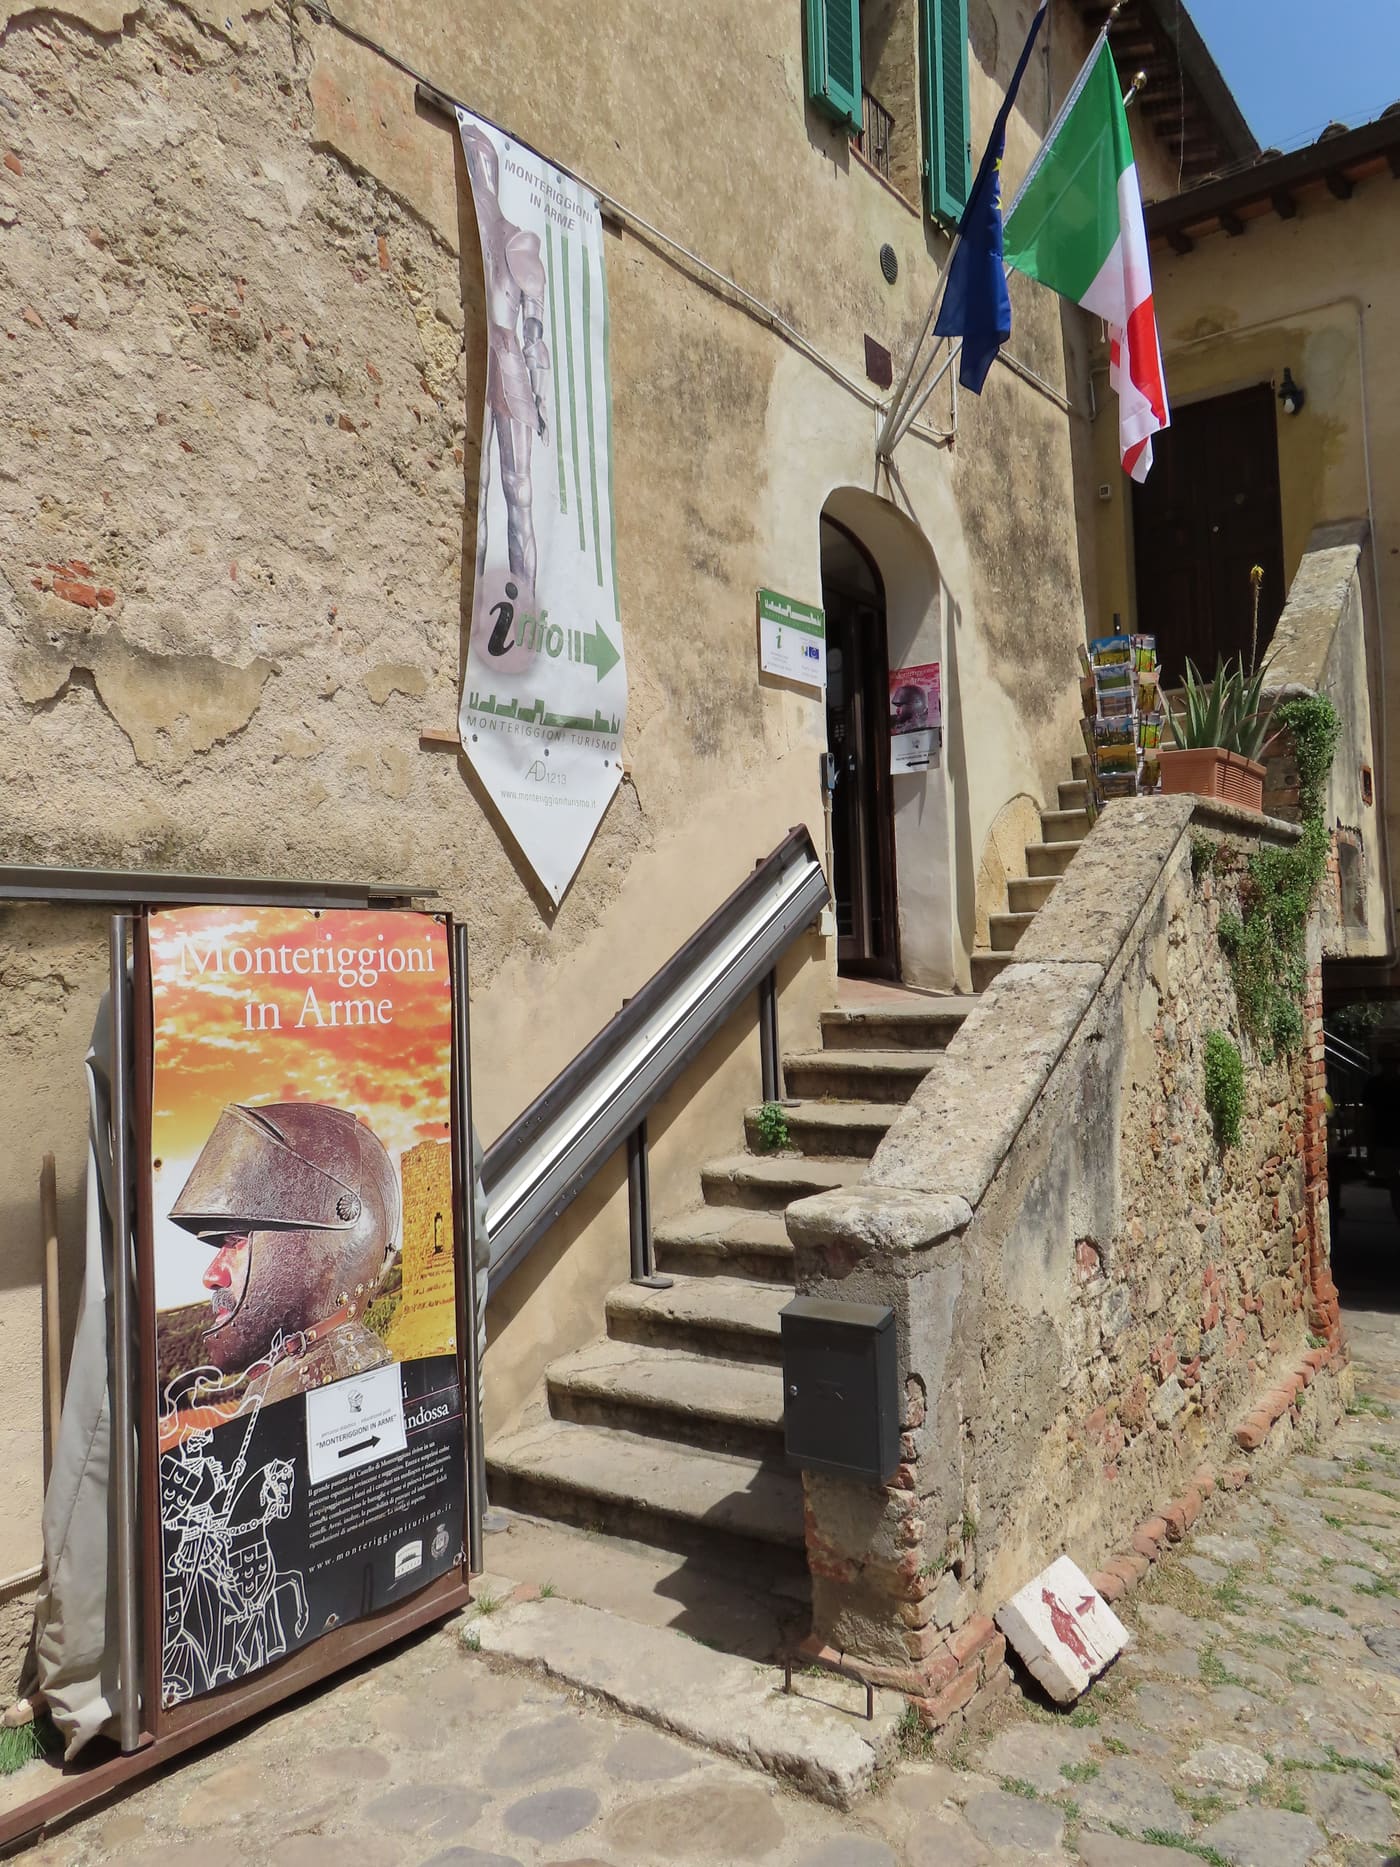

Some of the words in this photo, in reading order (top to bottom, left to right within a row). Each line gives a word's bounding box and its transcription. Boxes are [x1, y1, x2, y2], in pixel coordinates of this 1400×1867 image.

[505, 160, 593, 225] MONTERIGGIONI
[530, 193, 541, 208] IN
[544, 203, 576, 231] ARME
[466, 714, 566, 741] MONTERIGGIONI
[571, 734, 617, 752] TURISMO
[500, 790, 596, 808] www.monteriggioniturismo.it
[179, 933, 436, 988] Monteriggioni
[243, 996, 282, 1031] in
[294, 986, 393, 1028] Arme
[370, 1422, 377, 1430] IN
[308, 1503, 452, 1574] www.monteriggioniturismo.it
